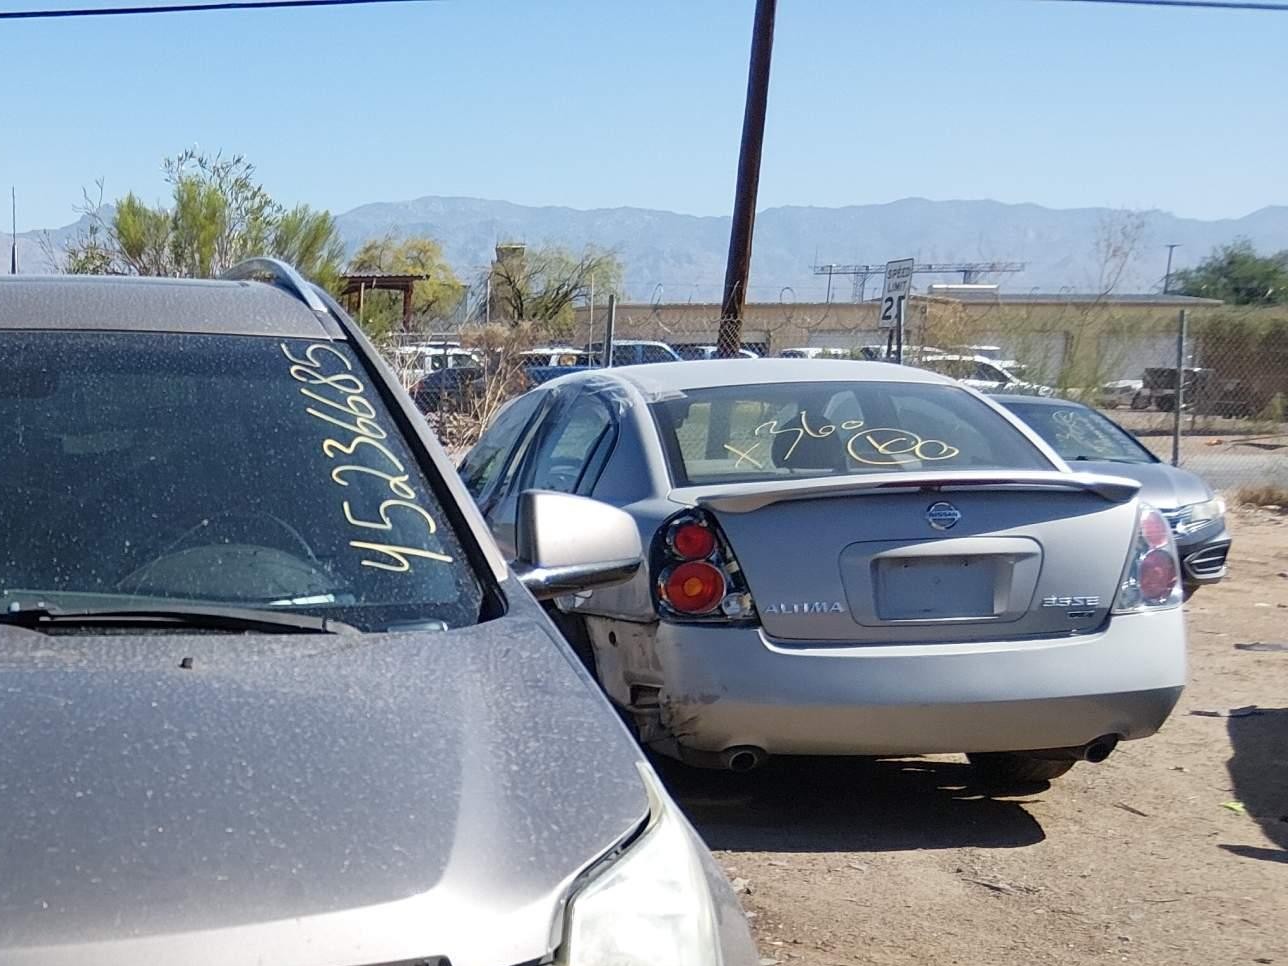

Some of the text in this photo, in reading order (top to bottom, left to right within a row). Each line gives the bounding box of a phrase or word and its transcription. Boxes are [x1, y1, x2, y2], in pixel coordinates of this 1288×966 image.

[887, 266, 911, 279] SPEED
[887, 280, 907, 293] LIMIT
[281, 342, 453, 571] 45236685
